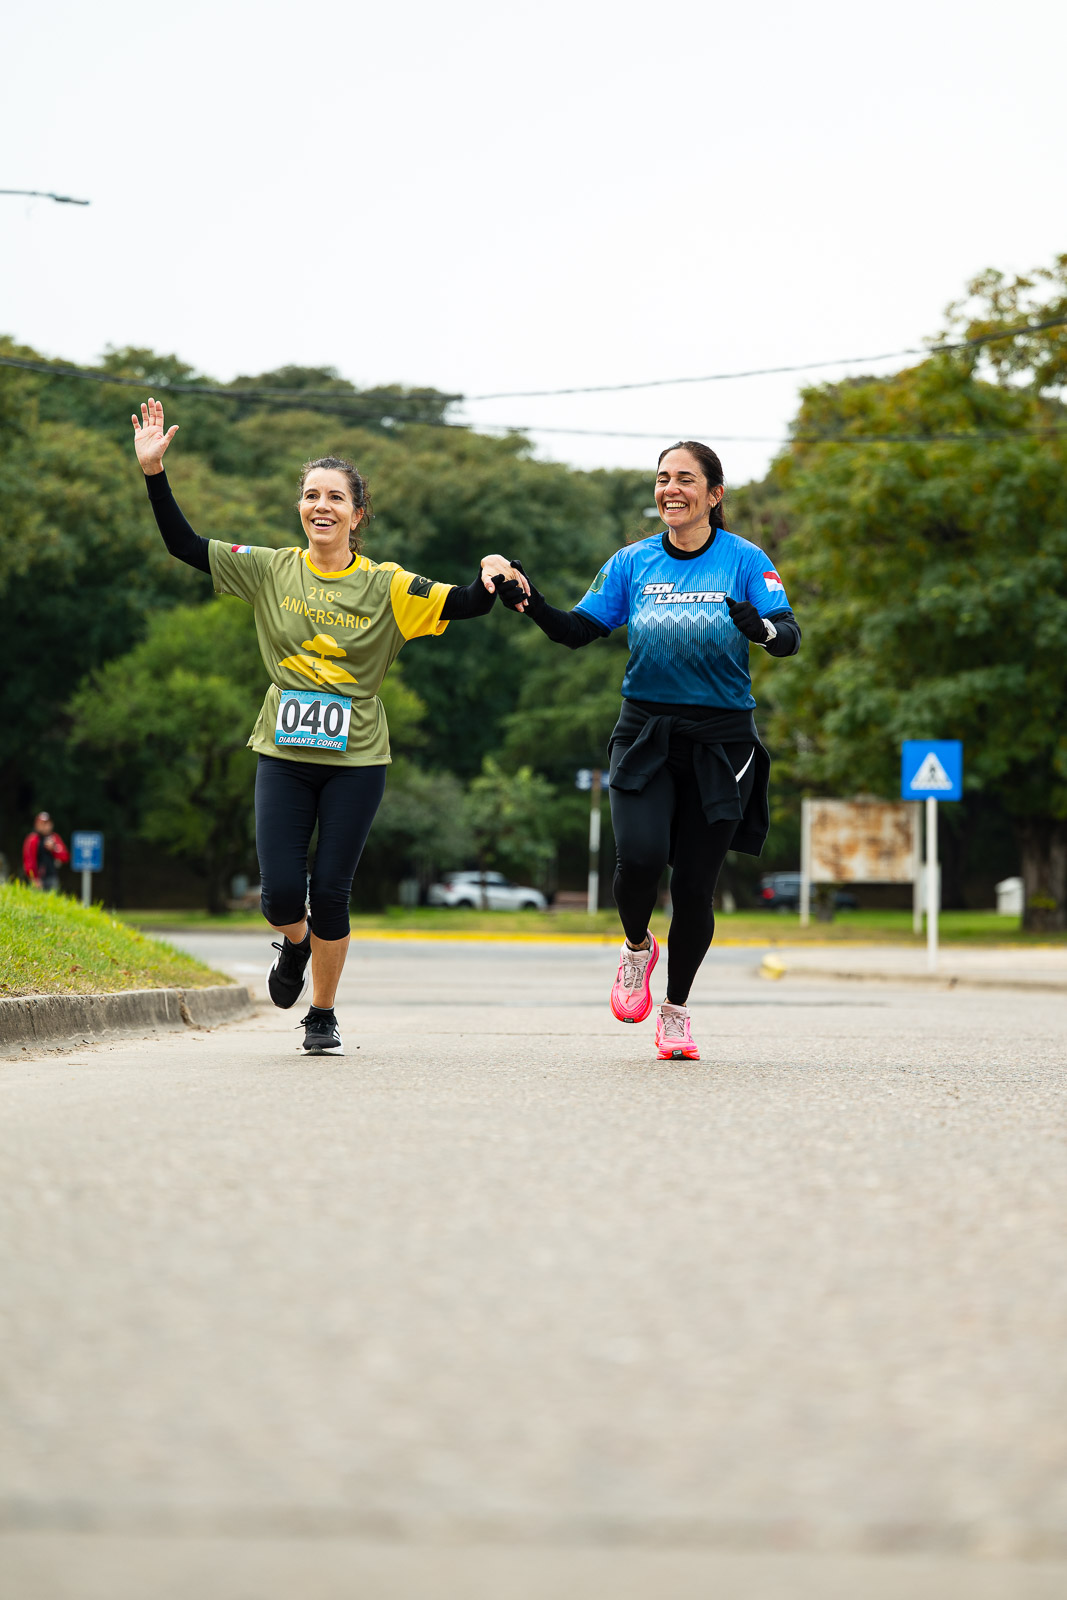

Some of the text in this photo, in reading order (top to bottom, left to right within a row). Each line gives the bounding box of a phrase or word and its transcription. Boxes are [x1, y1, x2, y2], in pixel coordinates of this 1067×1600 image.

[642, 583, 675, 595] SIN
[654, 591, 727, 604] LIMITES
[281, 698, 344, 738] 040
[278, 736, 344, 749] DIAMANTE CORRE
